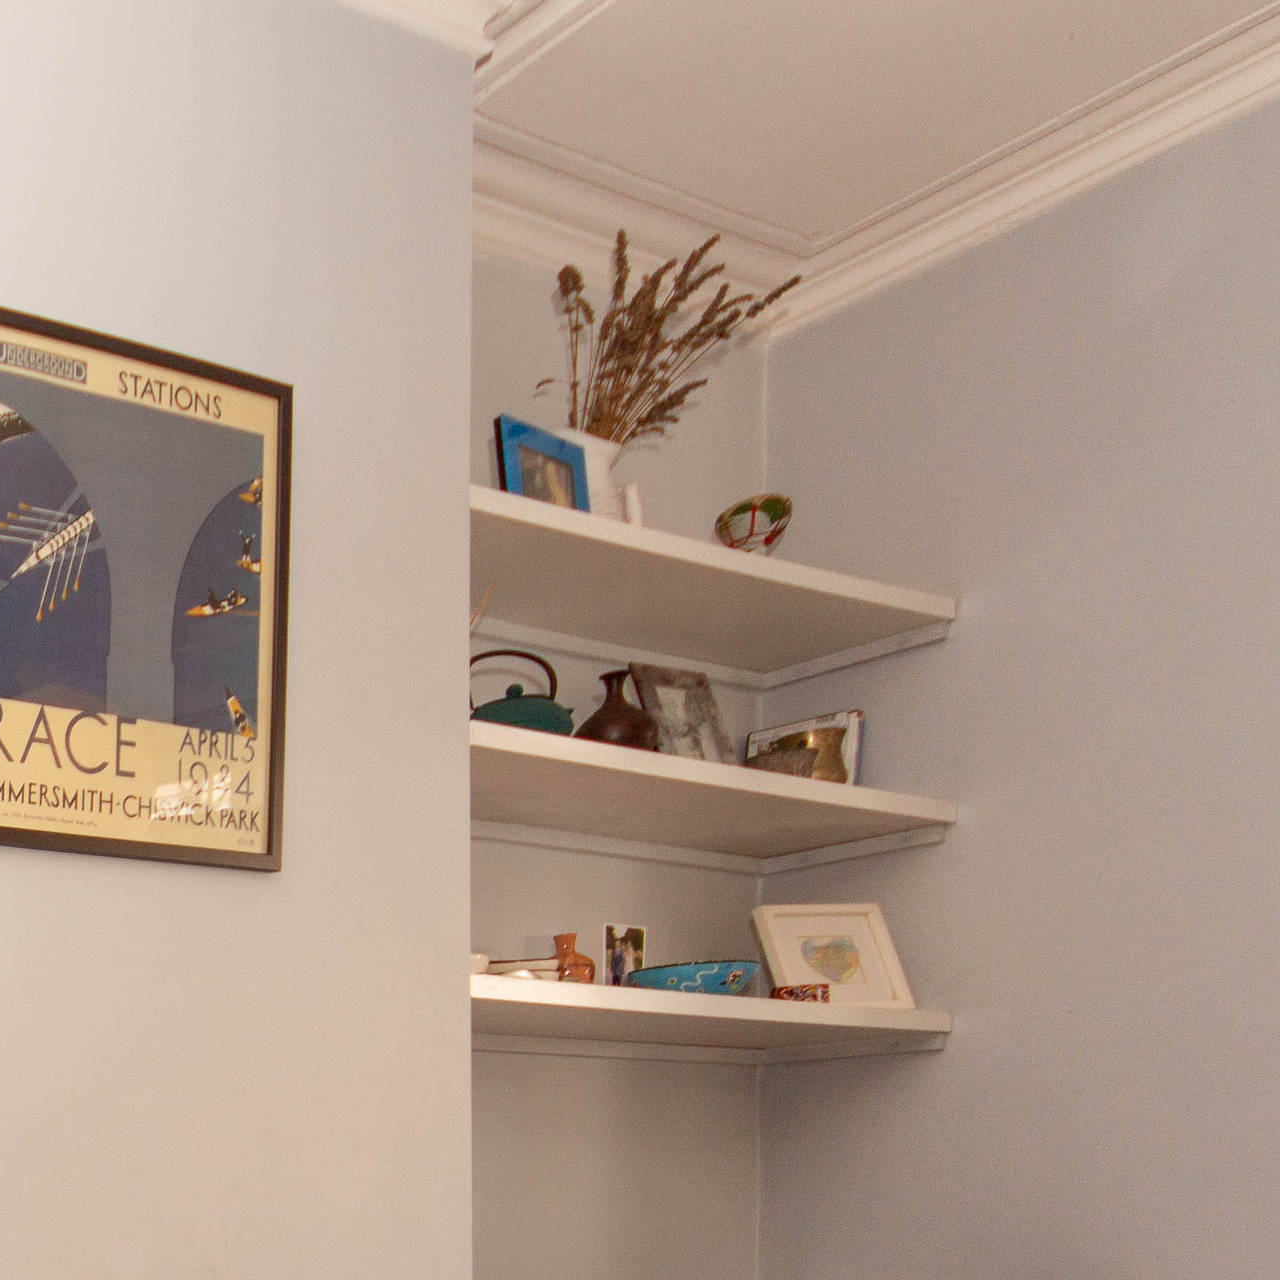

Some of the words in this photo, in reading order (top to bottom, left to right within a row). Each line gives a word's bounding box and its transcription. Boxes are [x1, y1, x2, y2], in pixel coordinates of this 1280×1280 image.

[119, 371, 222, 420] STATIONS
[179, 727, 241, 761] APRIL
[241, 737, 255, 763] 5
[123, 795, 218, 830] CHISWICK
[219, 809, 261, 834] PARK
